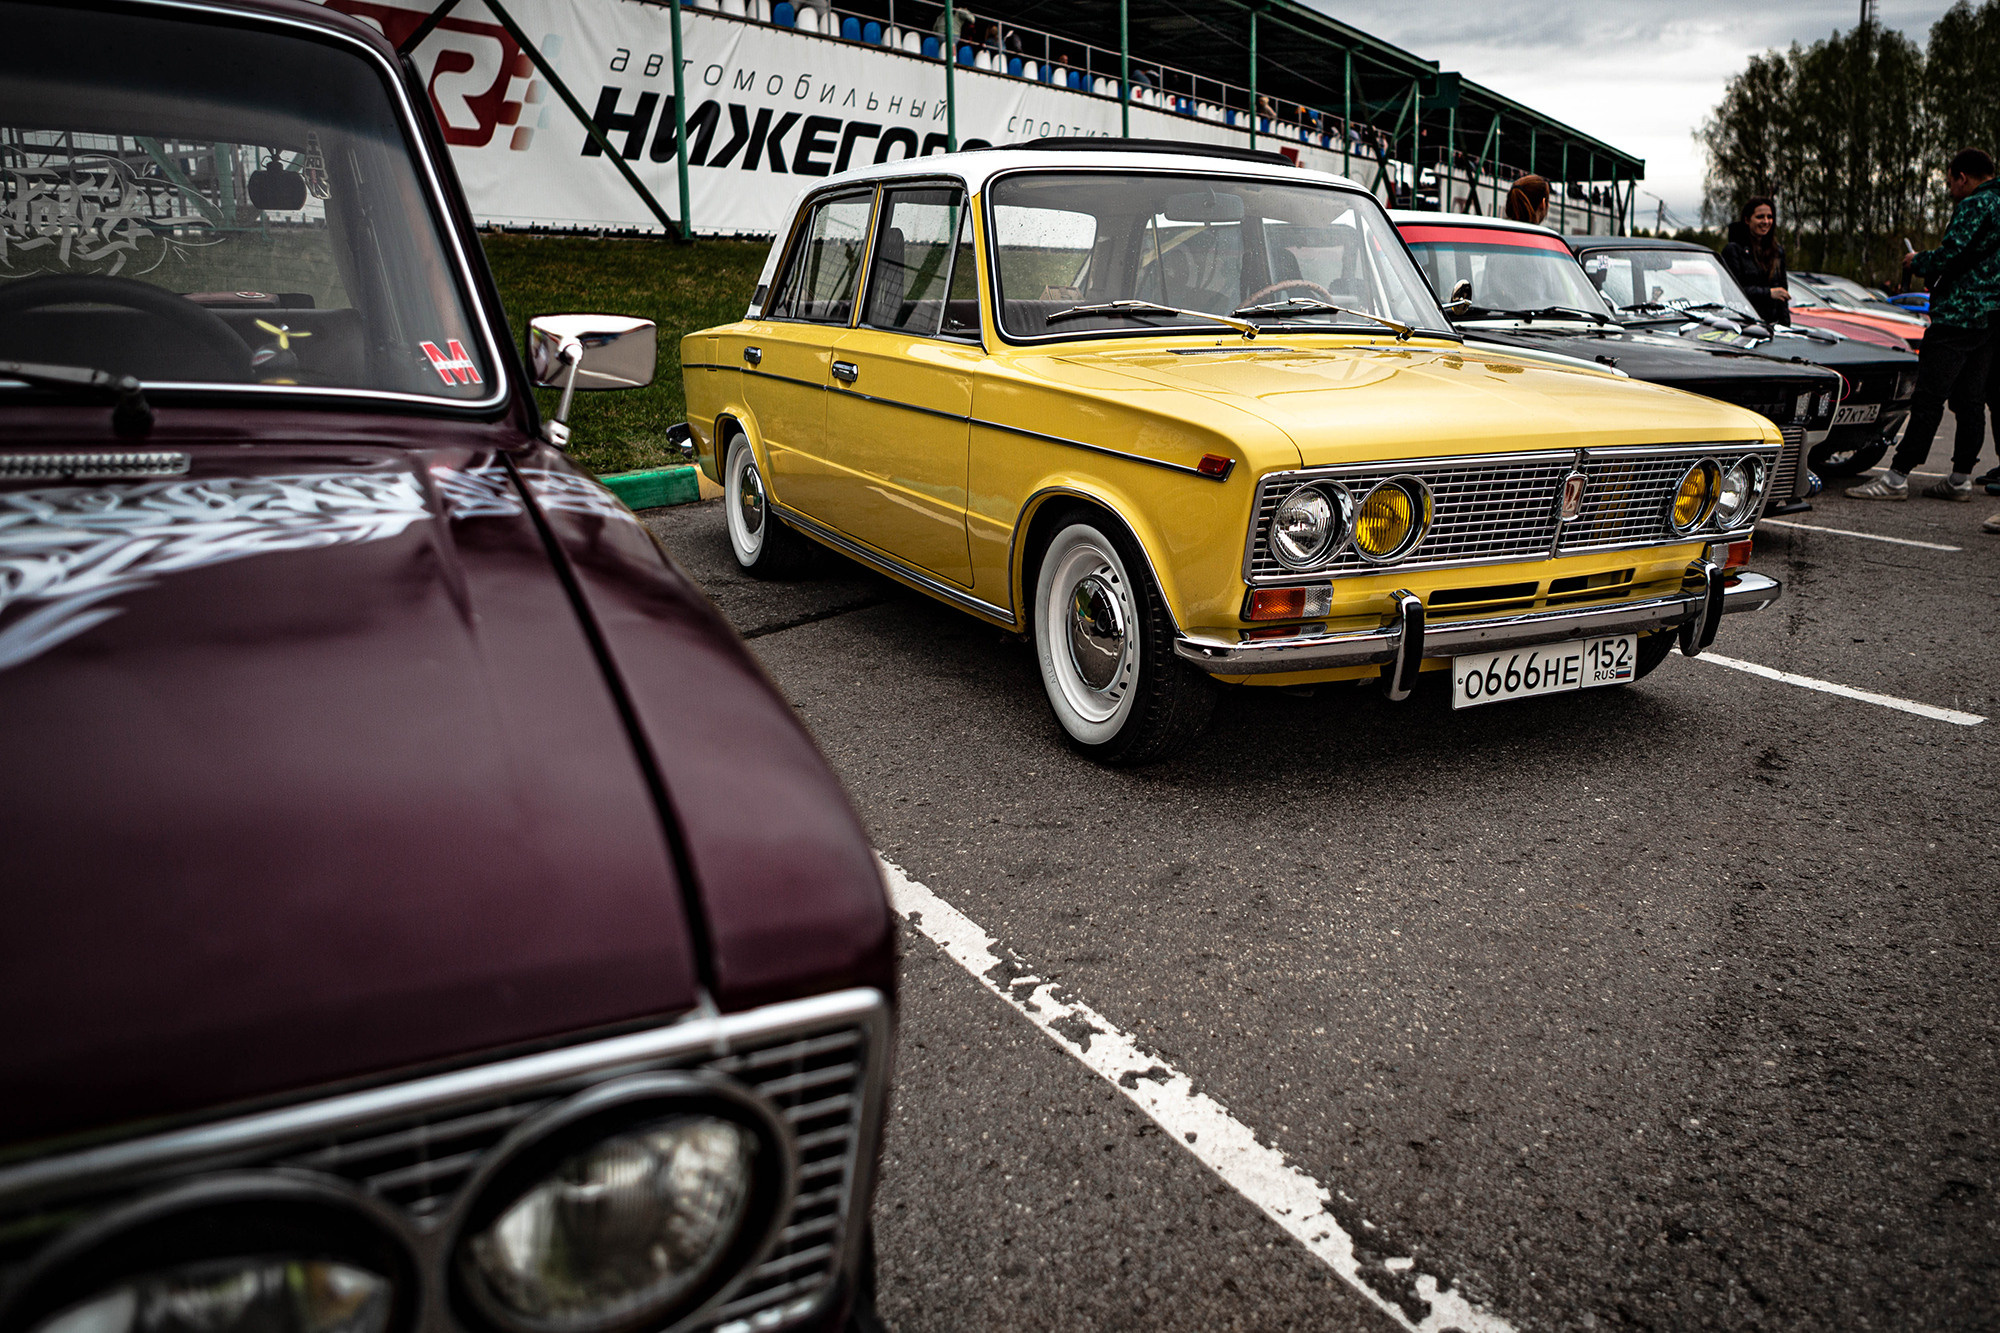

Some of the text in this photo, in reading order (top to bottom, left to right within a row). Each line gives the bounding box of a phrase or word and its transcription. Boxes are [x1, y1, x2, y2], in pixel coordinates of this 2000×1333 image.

[609, 48, 948, 121] автомобильный
[1588, 639, 1630, 670] 152
[1593, 669, 1615, 681] RUS
